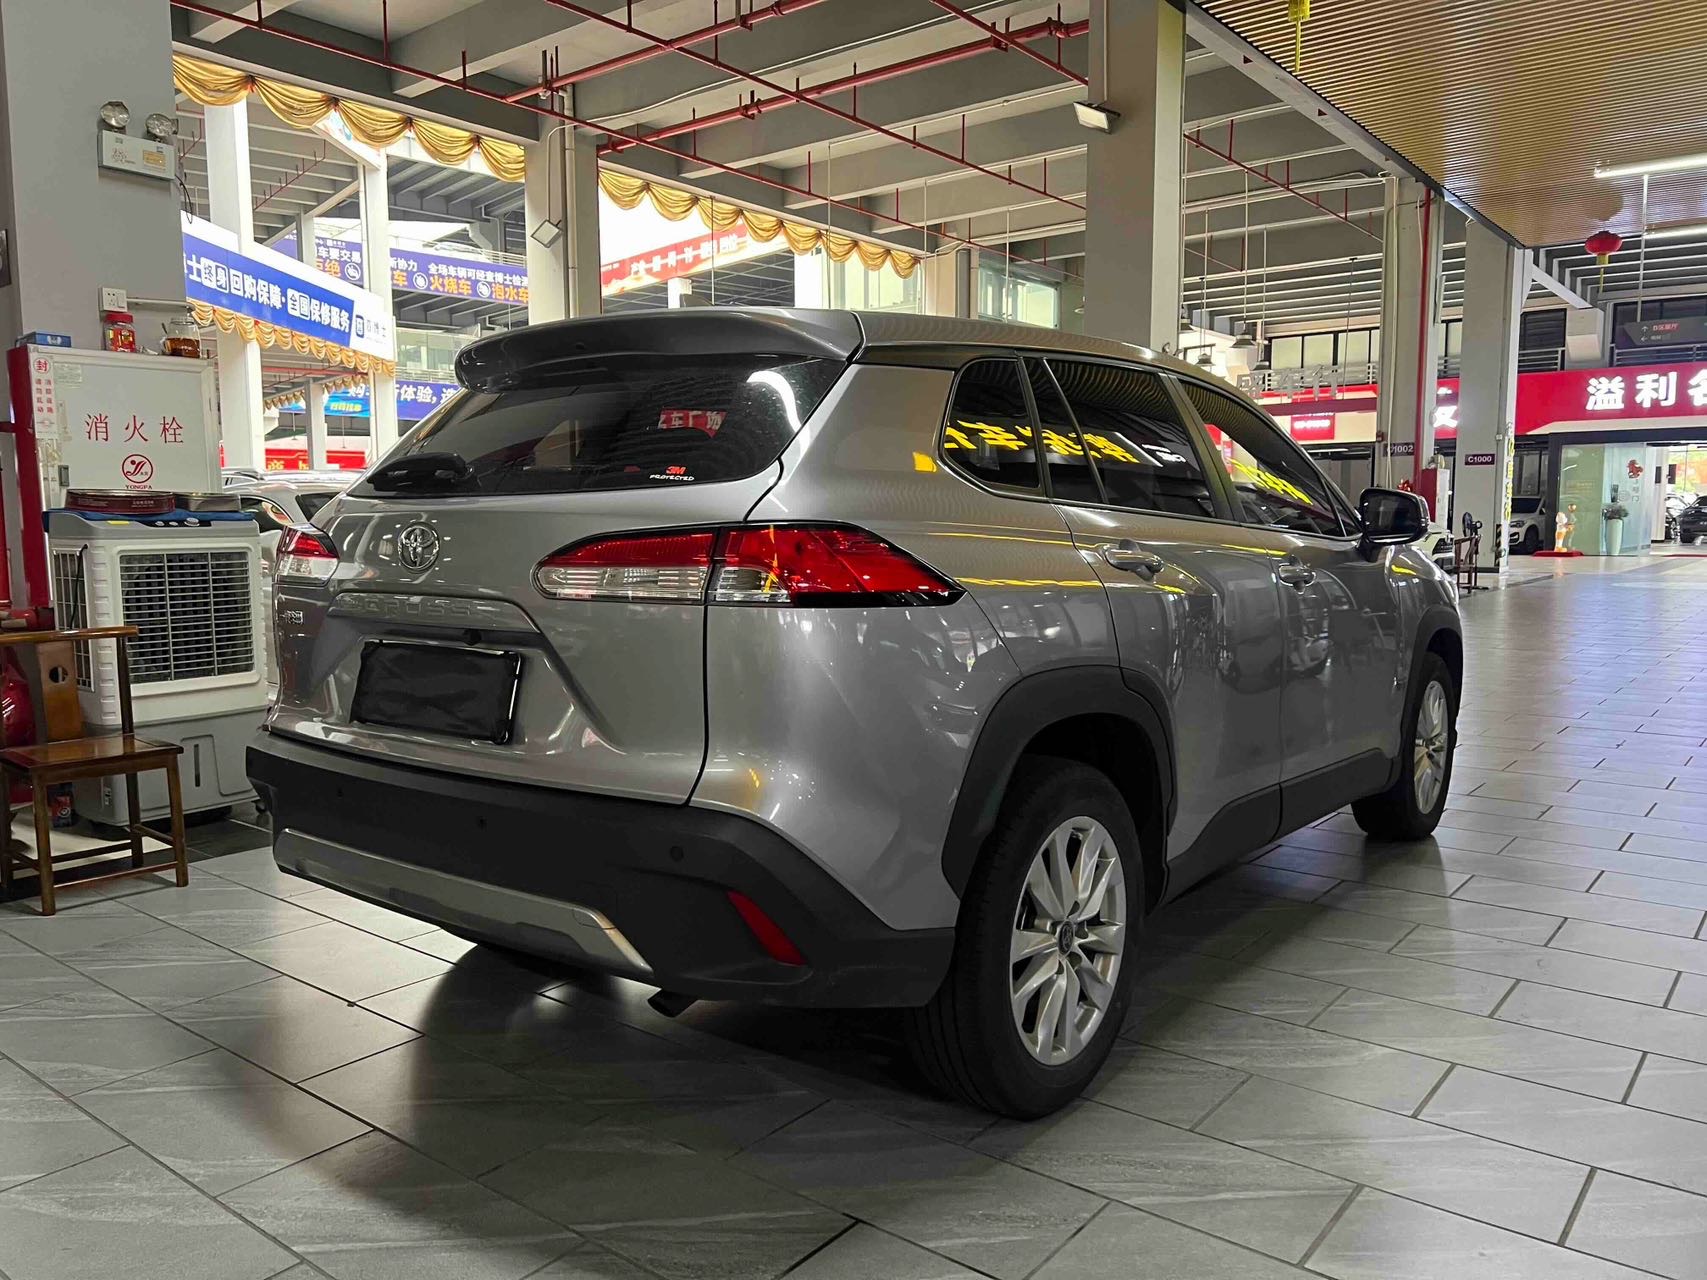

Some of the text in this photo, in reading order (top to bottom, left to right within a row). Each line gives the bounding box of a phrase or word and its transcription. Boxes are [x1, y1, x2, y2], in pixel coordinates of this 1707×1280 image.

[316, 244, 361, 264] 车要交易
[184, 251, 350, 334] 士终身回购保障·全国保修服务
[430, 274, 473, 296] 火烧车
[36, 359, 48, 372] 封
[85, 413, 184, 444] 消火栓
[1467, 455, 1492, 464] C1000
[666, 465, 687, 475] 3M
